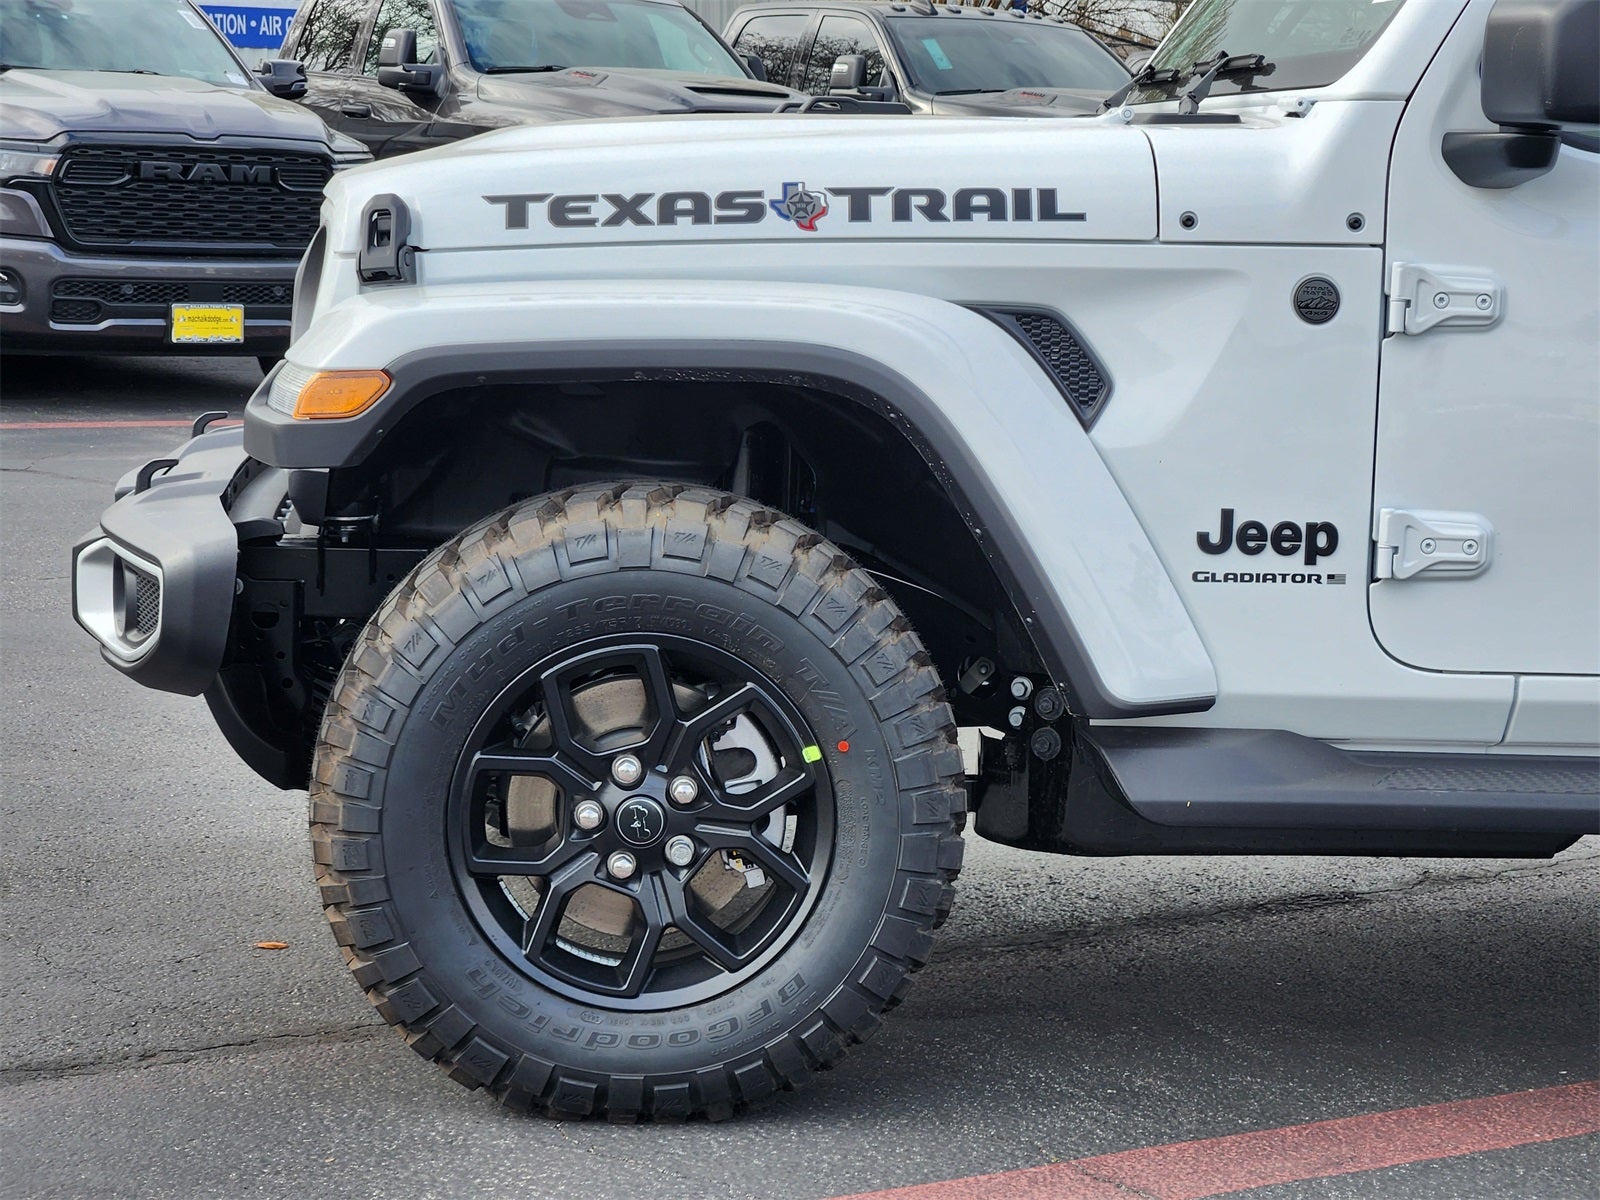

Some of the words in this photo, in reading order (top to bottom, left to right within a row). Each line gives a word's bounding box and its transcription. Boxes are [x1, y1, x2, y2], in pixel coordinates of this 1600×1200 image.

[259, 15, 282, 36] AIR
[140, 160, 272, 182] RAM
[481, 189, 765, 230] TEXAS
[824, 186, 1087, 223] TRAIL
[1196, 508, 1339, 566] Jeep
[1192, 571, 1323, 585] GLADIATOR
